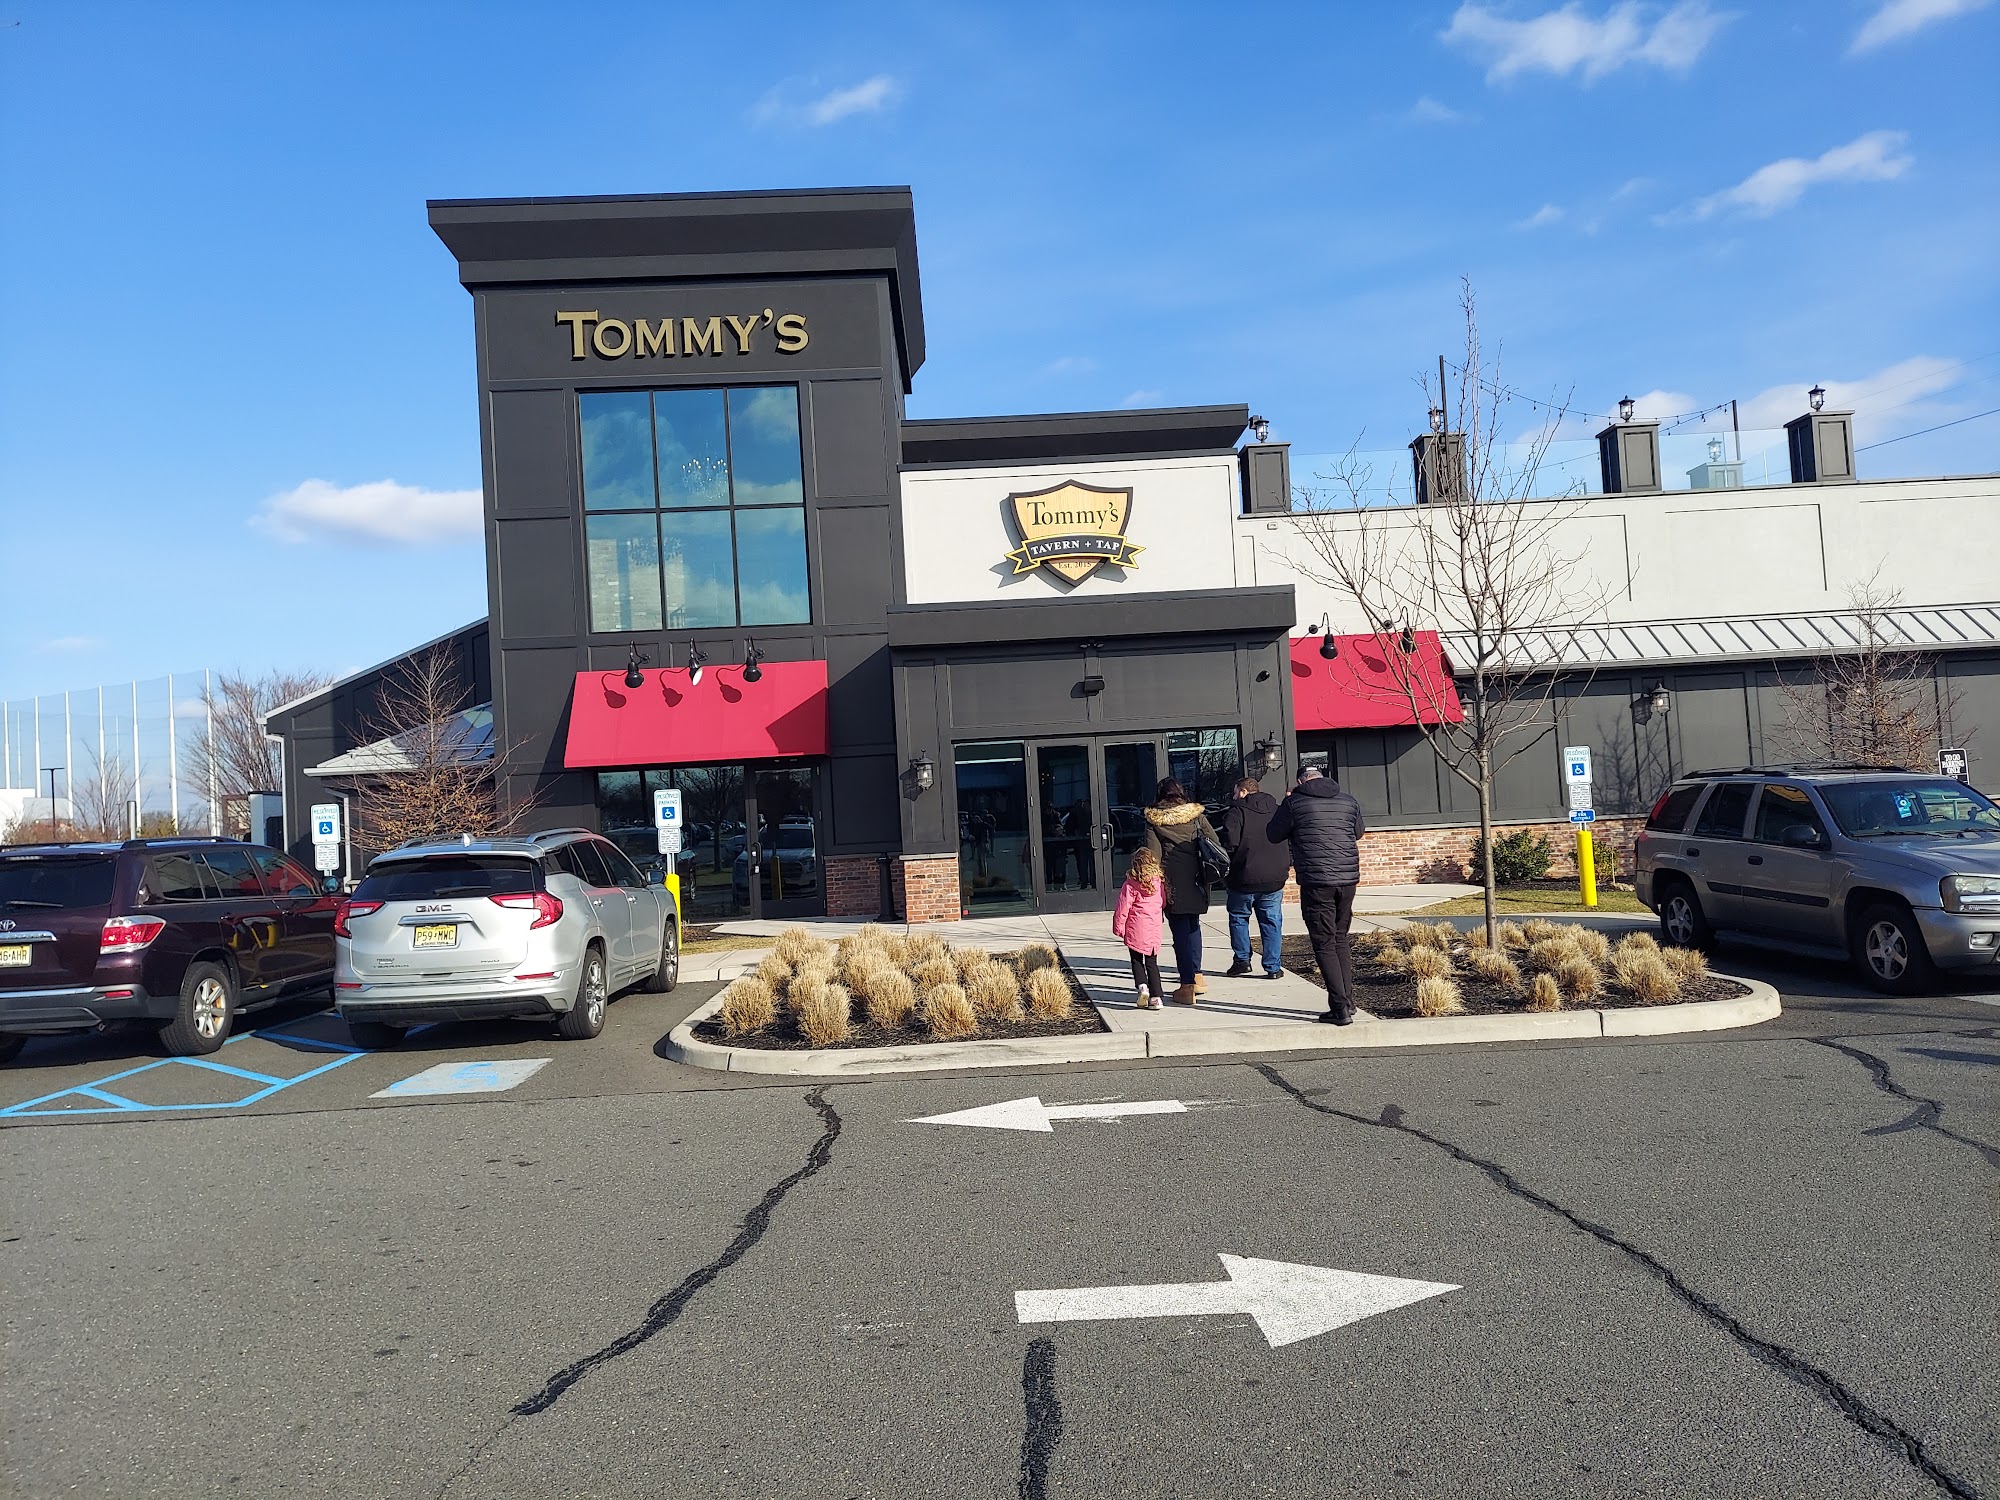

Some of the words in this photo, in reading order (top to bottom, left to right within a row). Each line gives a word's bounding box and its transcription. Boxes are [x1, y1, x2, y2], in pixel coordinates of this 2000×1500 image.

[556, 308, 809, 359] TOMMY'S
[1026, 500, 1119, 530] Tommy's
[1030, 540, 1080, 555] TAVERN
[1096, 540, 1120, 551] TAP
[1941, 760, 1965, 768] PARKING
